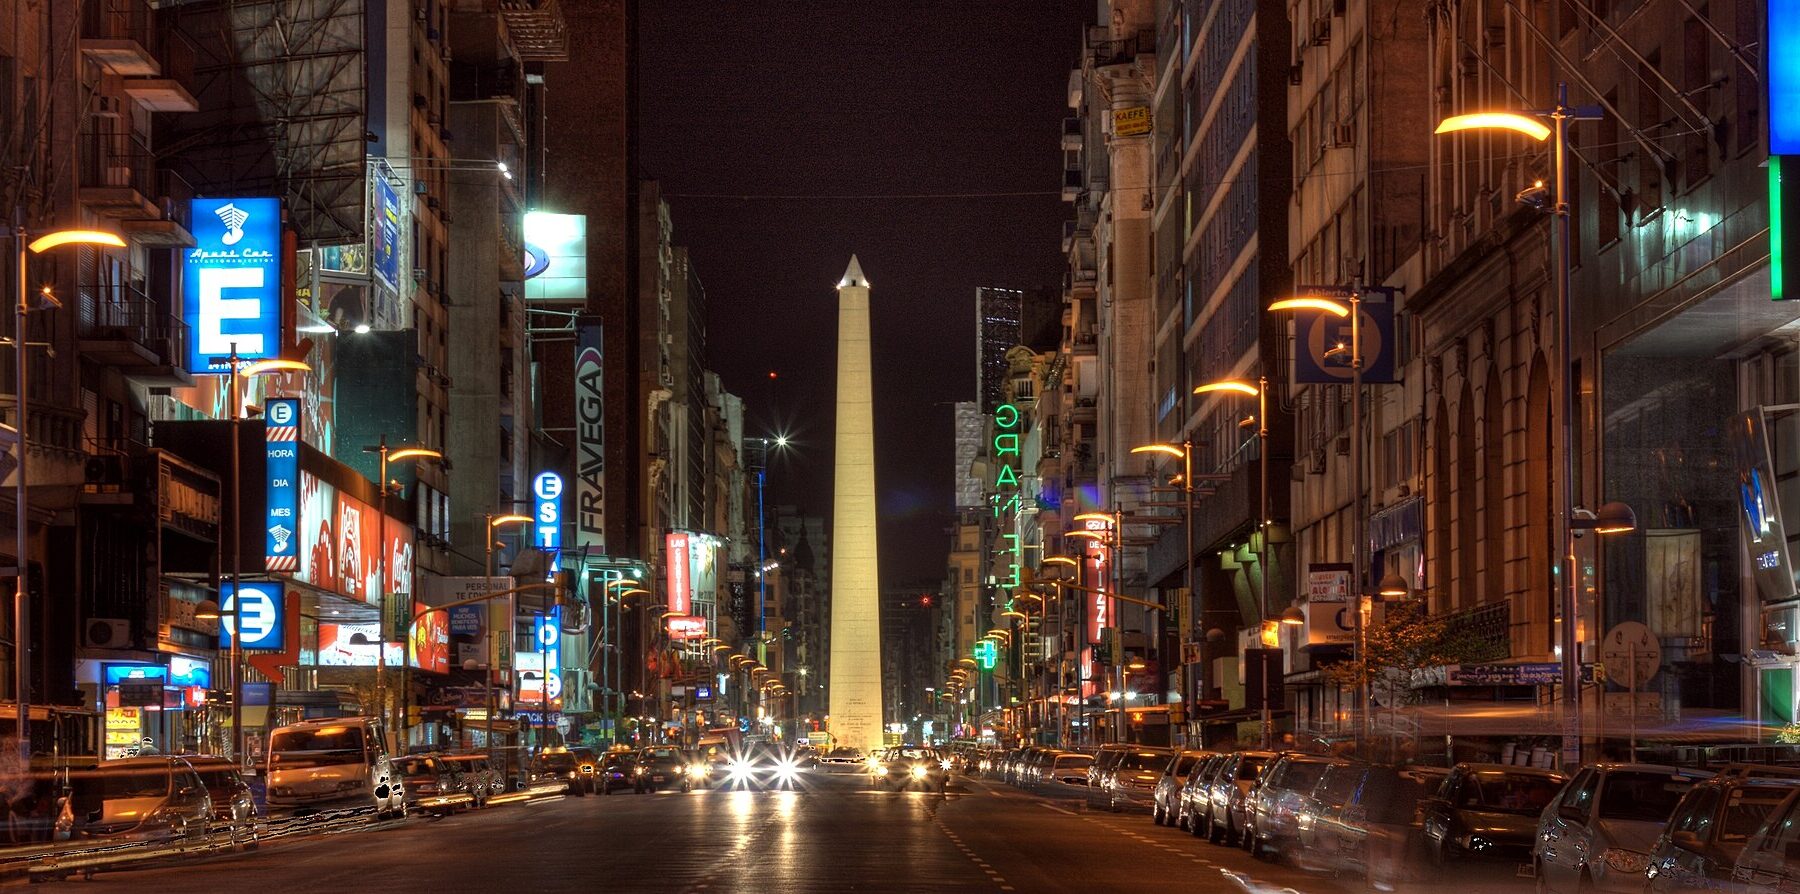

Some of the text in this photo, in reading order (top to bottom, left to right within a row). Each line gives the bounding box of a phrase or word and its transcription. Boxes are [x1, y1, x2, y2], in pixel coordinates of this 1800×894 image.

[1115, 108, 1144, 120] KAEFE
[242, 248, 273, 257] Car
[199, 267, 264, 354] E
[277, 406, 287, 420] E
[268, 450, 294, 458] HORA
[273, 479, 288, 487] DIA
[271, 508, 291, 517] MES
[670, 539, 685, 548] LAS
[1089, 541, 1100, 549] DE
[238, 596, 262, 635] E
